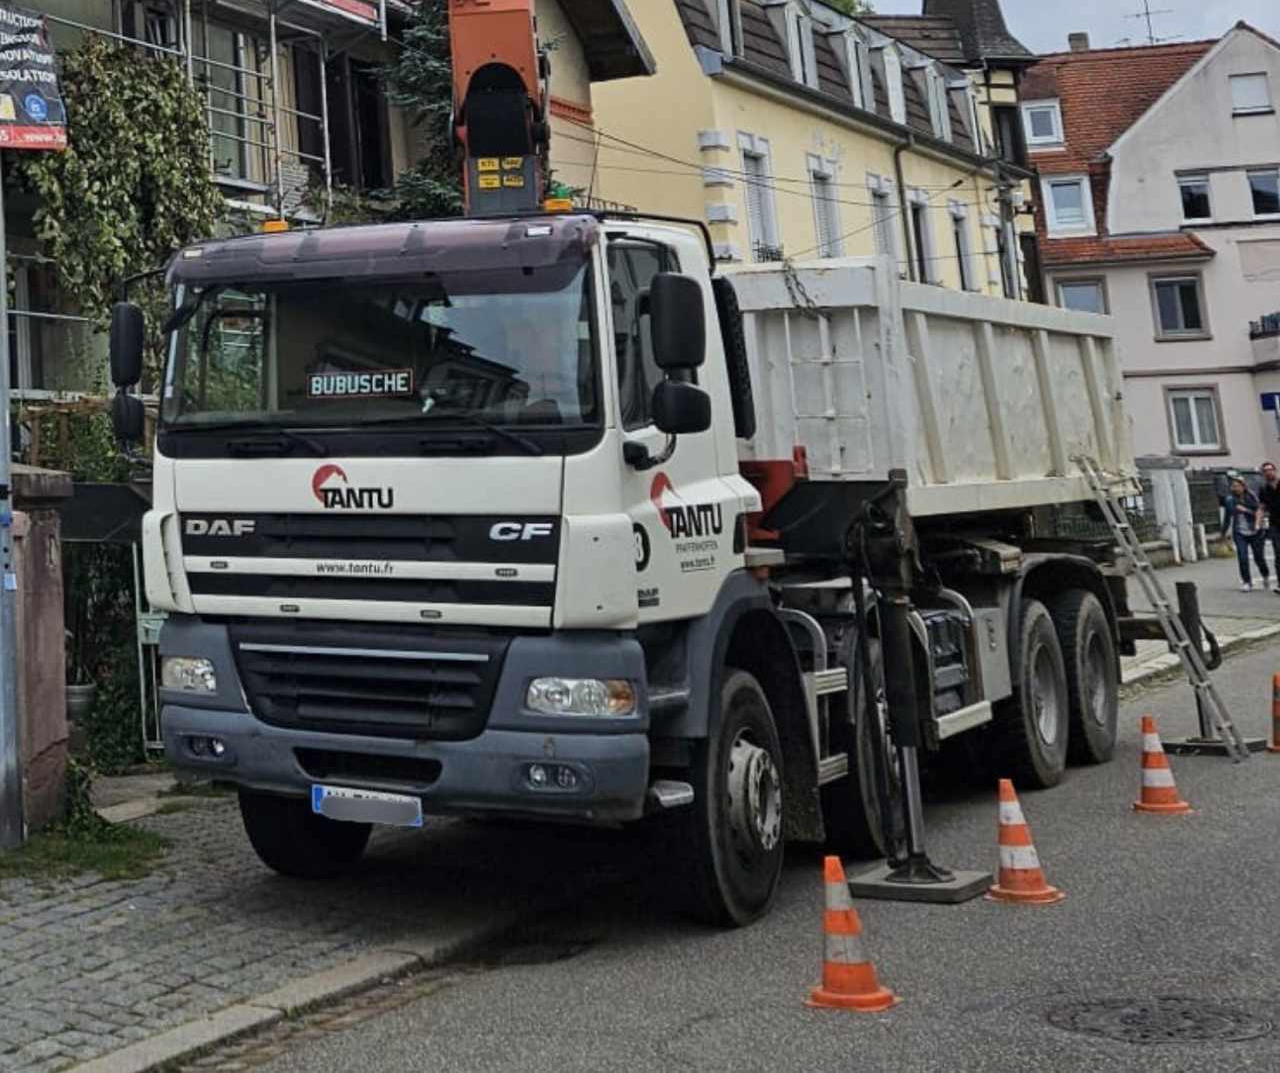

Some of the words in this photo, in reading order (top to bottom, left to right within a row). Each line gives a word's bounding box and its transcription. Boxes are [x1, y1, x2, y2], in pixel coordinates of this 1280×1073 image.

[312, 373, 408, 395] BUBUSCHE
[319, 487, 394, 509] TANTU
[185, 519, 256, 536] DAF
[664, 503, 723, 539] TANTU
[489, 522, 553, 541] CF
[317, 563, 394, 575] www.tantu.fr
